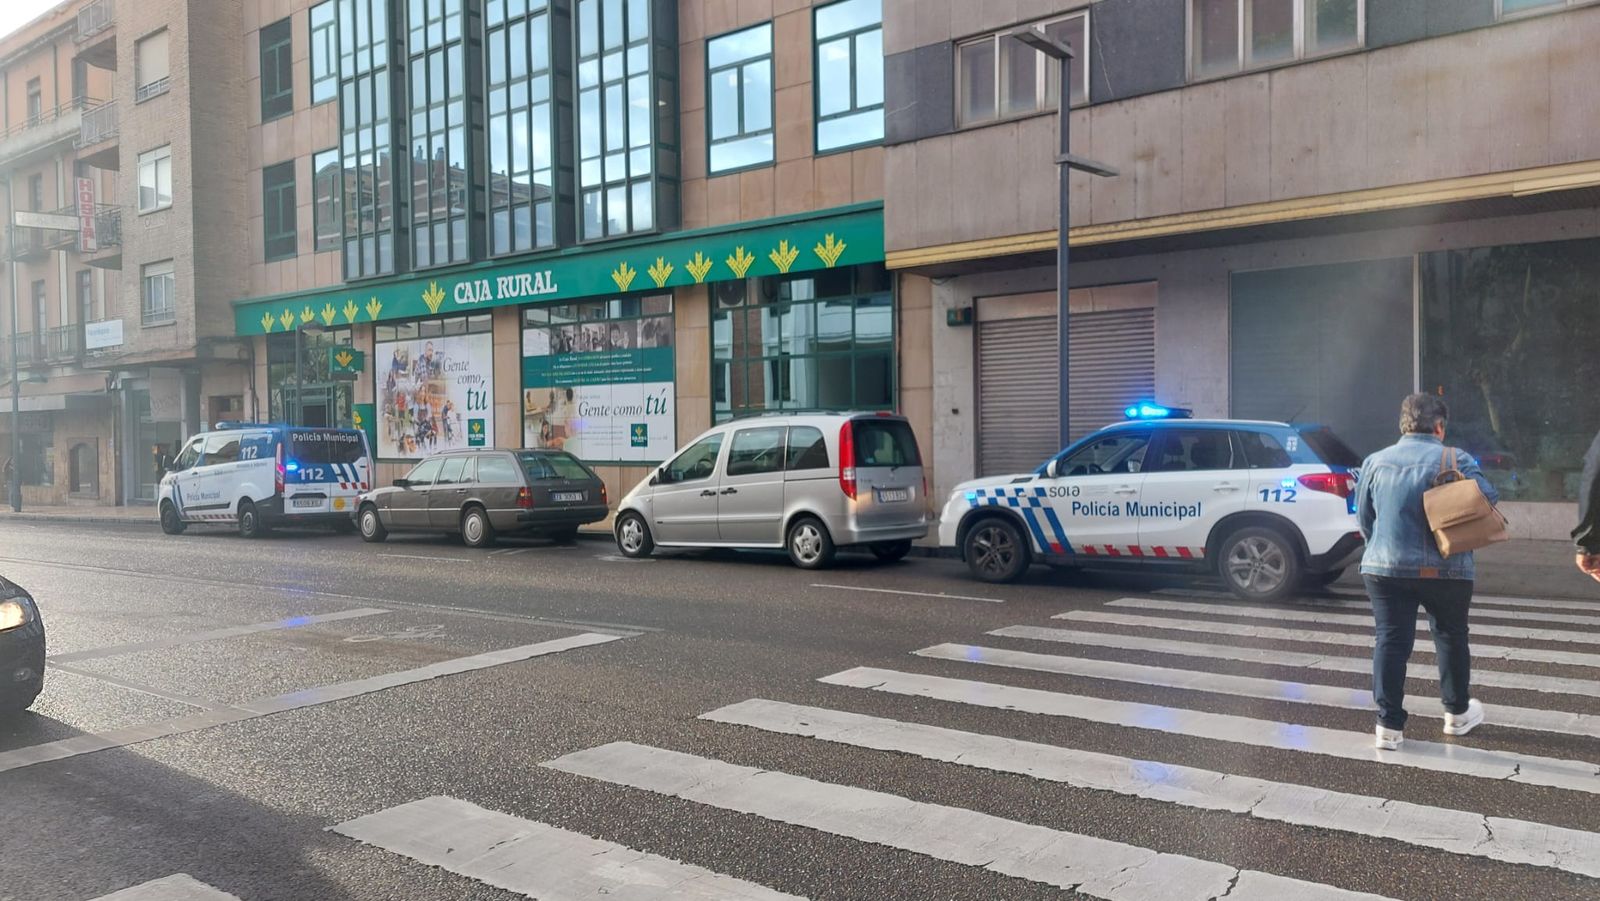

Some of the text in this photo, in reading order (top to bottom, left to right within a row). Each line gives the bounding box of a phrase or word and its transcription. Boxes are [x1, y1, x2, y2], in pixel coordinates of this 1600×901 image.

[79, 180, 95, 250] HOSTAL
[454, 270, 558, 304] CAJA RURAL
[443, 357, 470, 372] Gente
[457, 374, 481, 385] como
[466, 380, 488, 411] tú
[578, 388, 667, 417] Gente como tú
[323, 432, 359, 444] Municipal
[241, 446, 258, 459] 112
[297, 468, 324, 480] 112
[1258, 488, 1297, 503] 112
[1072, 500, 1202, 521] Policía Municipal
